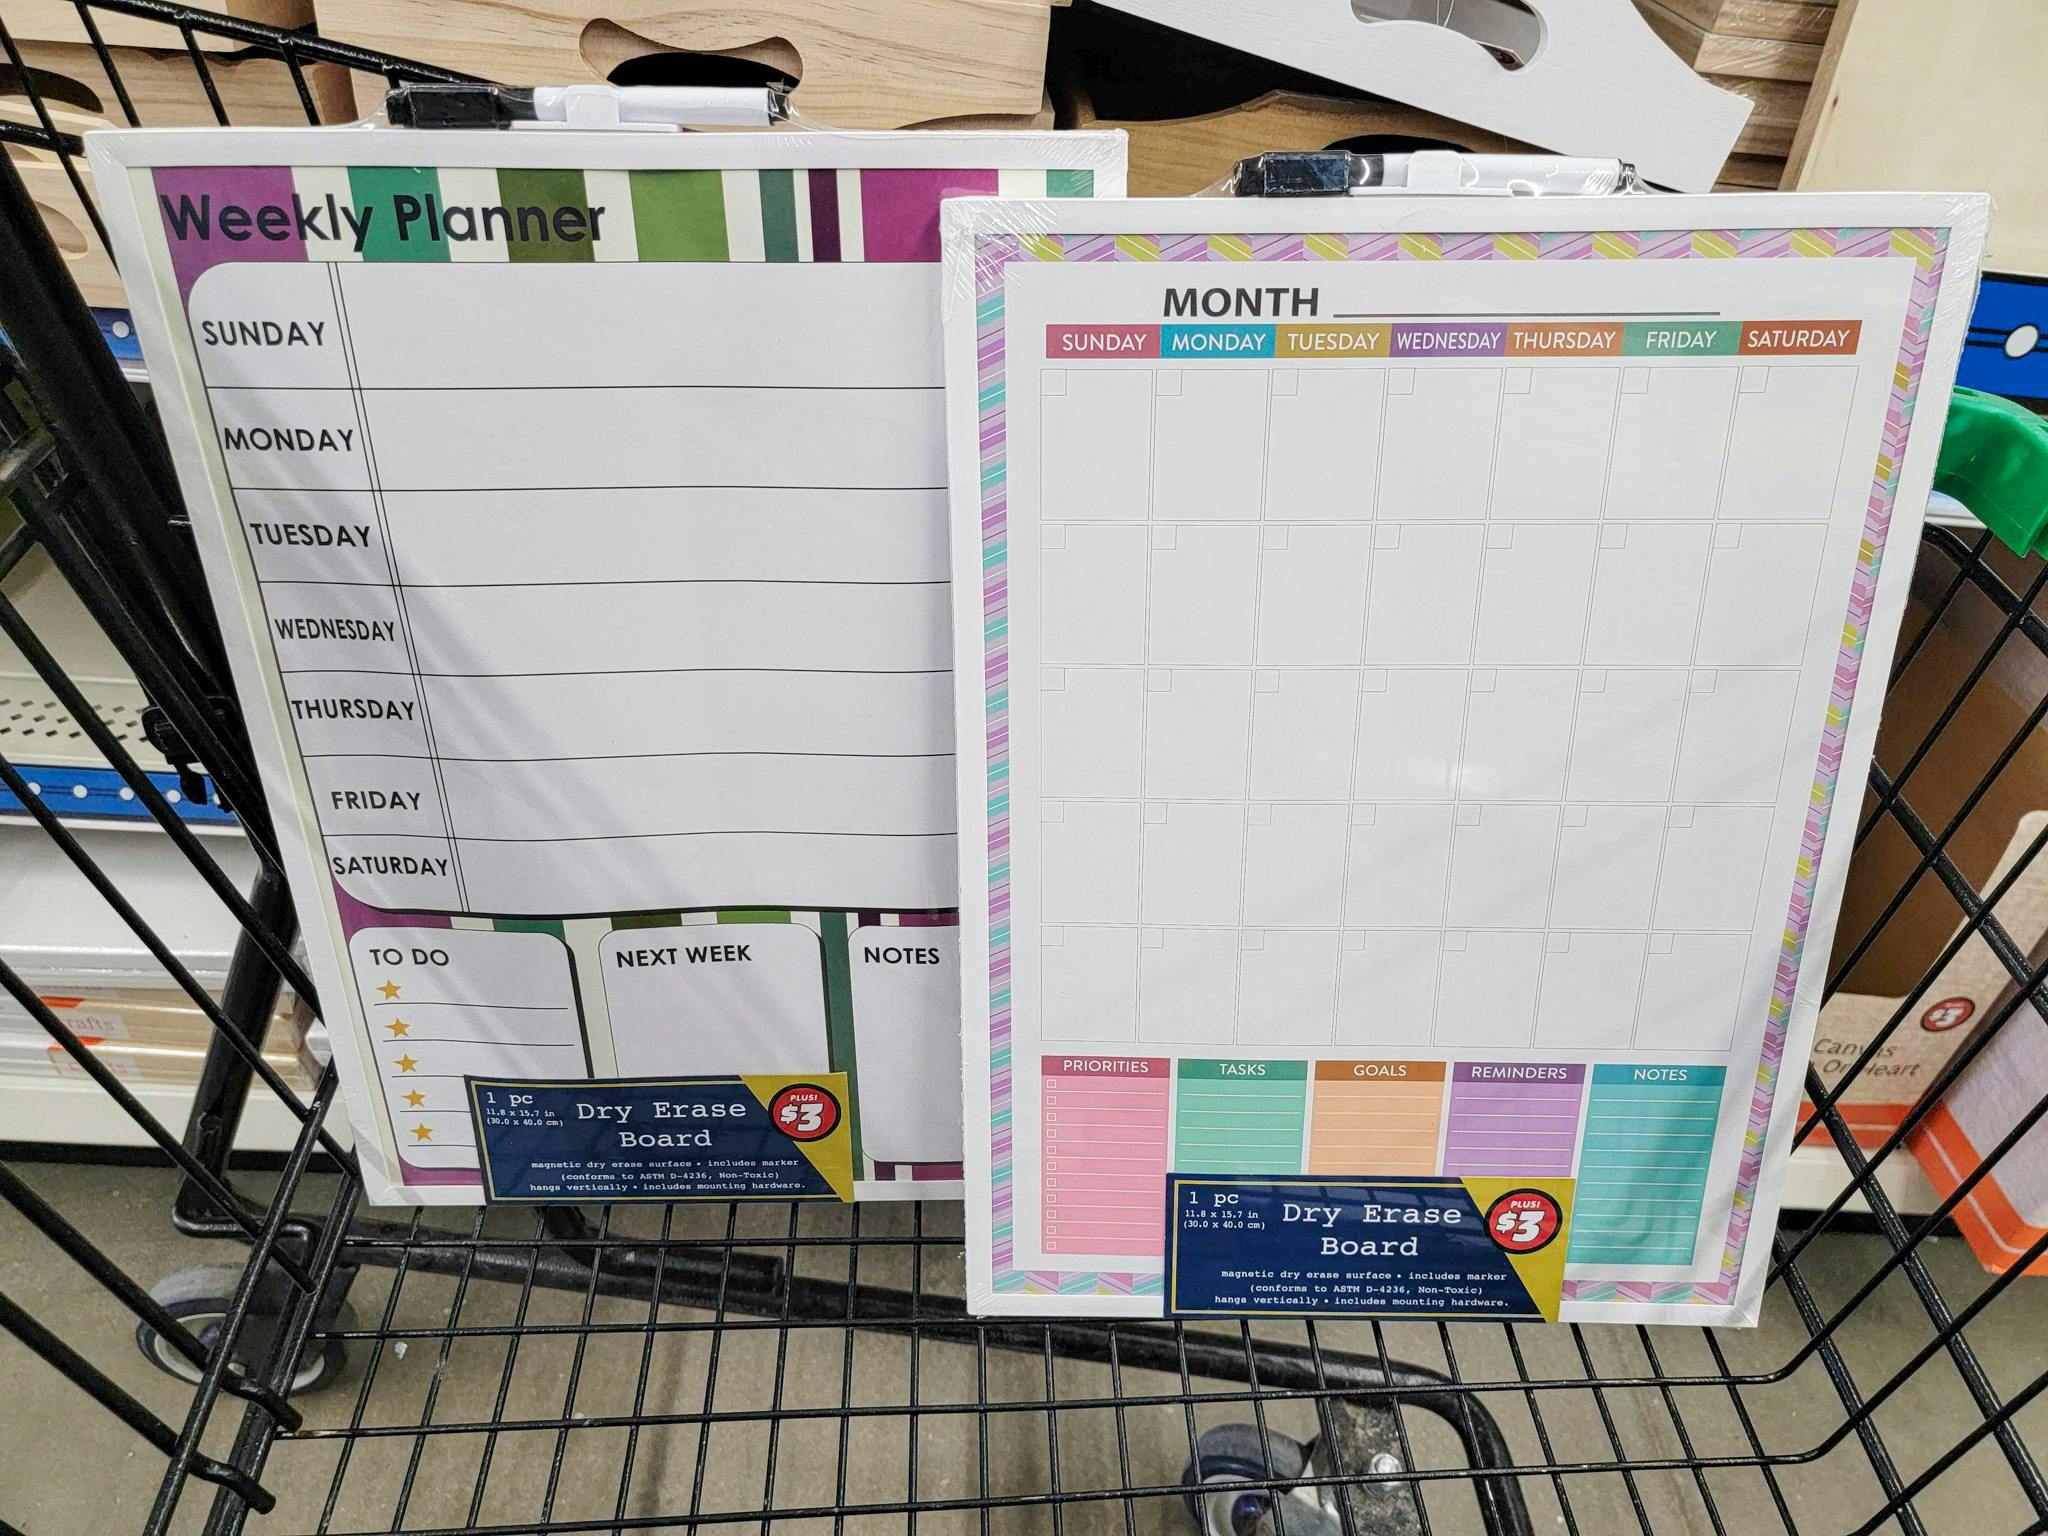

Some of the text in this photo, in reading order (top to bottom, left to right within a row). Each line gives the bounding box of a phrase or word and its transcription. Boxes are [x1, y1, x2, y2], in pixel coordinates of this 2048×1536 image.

[160, 193, 605, 251] Weekly Planner
[1164, 288, 1318, 317] MONTH
[202, 321, 324, 346] SUNDAY
[1063, 330, 1850, 351] SUNDAY MONDAY TUESDAY WEDNESDAY THURSDAY FRIDAY SATURDAY
[224, 428, 353, 451] MONDAY
[250, 523, 370, 547] TUESDAY
[275, 619, 394, 641] WEDNESDAY
[291, 699, 414, 720] THURSDAY
[331, 791, 420, 810] FRIDAY
[332, 856, 447, 876] SATURDAY
[369, 949, 449, 966] TO DO
[617, 945, 752, 968] NEXT WEEK
[865, 947, 939, 964] NOTES
[1814, 1039, 1898, 1057] Cans
[1064, 1060, 1148, 1072] PRIORITIES
[1220, 1064, 1265, 1075] TASKS
[1354, 1065, 1406, 1076] GOALS
[1472, 1066, 1567, 1079] REMINDERS
[1634, 1069, 1687, 1080] NOTES
[487, 1092, 533, 1106] 1 pc
[789, 1093, 818, 1102] PLUS!
[485, 1107, 506, 1116] 11.8
[519, 1109, 540, 1117] 15.7
[544, 1109, 555, 1118] in
[577, 1102, 746, 1123] Dry Erase
[781, 1103, 823, 1133] $3
[486, 1117, 510, 1126] (30.0
[522, 1118, 543, 1126] 40.0
[545, 1119, 564, 1128] cm)
[619, 1130, 712, 1147] Board
[531, 1160, 581, 1170] magnetic
[586, 1161, 606, 1170] dry
[648, 1160, 692, 1168] surface
[707, 1159, 757, 1167] includes
[761, 1159, 799, 1167] marker
[561, 1173, 616, 1182] (conforms
[639, 1172, 665, 1180] ASTM
[669, 1171, 712, 1180] D-4236,
[718, 1171, 779, 1180] Non-Toxic)
[529, 1181, 806, 1193] hangs vertically includes mounting hardware.
[1190, 1192, 1238, 1207] 1 pc
[1510, 1200, 1541, 1209] PLUS!
[1185, 1209, 1207, 1218] 11.8
[1221, 1210, 1243, 1219] 15.7
[1247, 1210, 1259, 1219] in
[1283, 1204, 1461, 1227] Dry Erase
[1183, 1219, 1209, 1229] (30.0
[1222, 1220, 1244, 1229] 40.0
[1247, 1221, 1266, 1231] cm)
[1496, 1210, 1545, 1242] $3
[1321, 1237, 1418, 1255] Board
[1221, 1269, 1507, 1281] magnetic dry erase surface includes marker
[1250, 1283, 1483, 1296] (conforms to ASTM D-4236, Non-Toxic)
[1214, 1295, 1509, 1308] hangs vertically includes mounting hardware.
